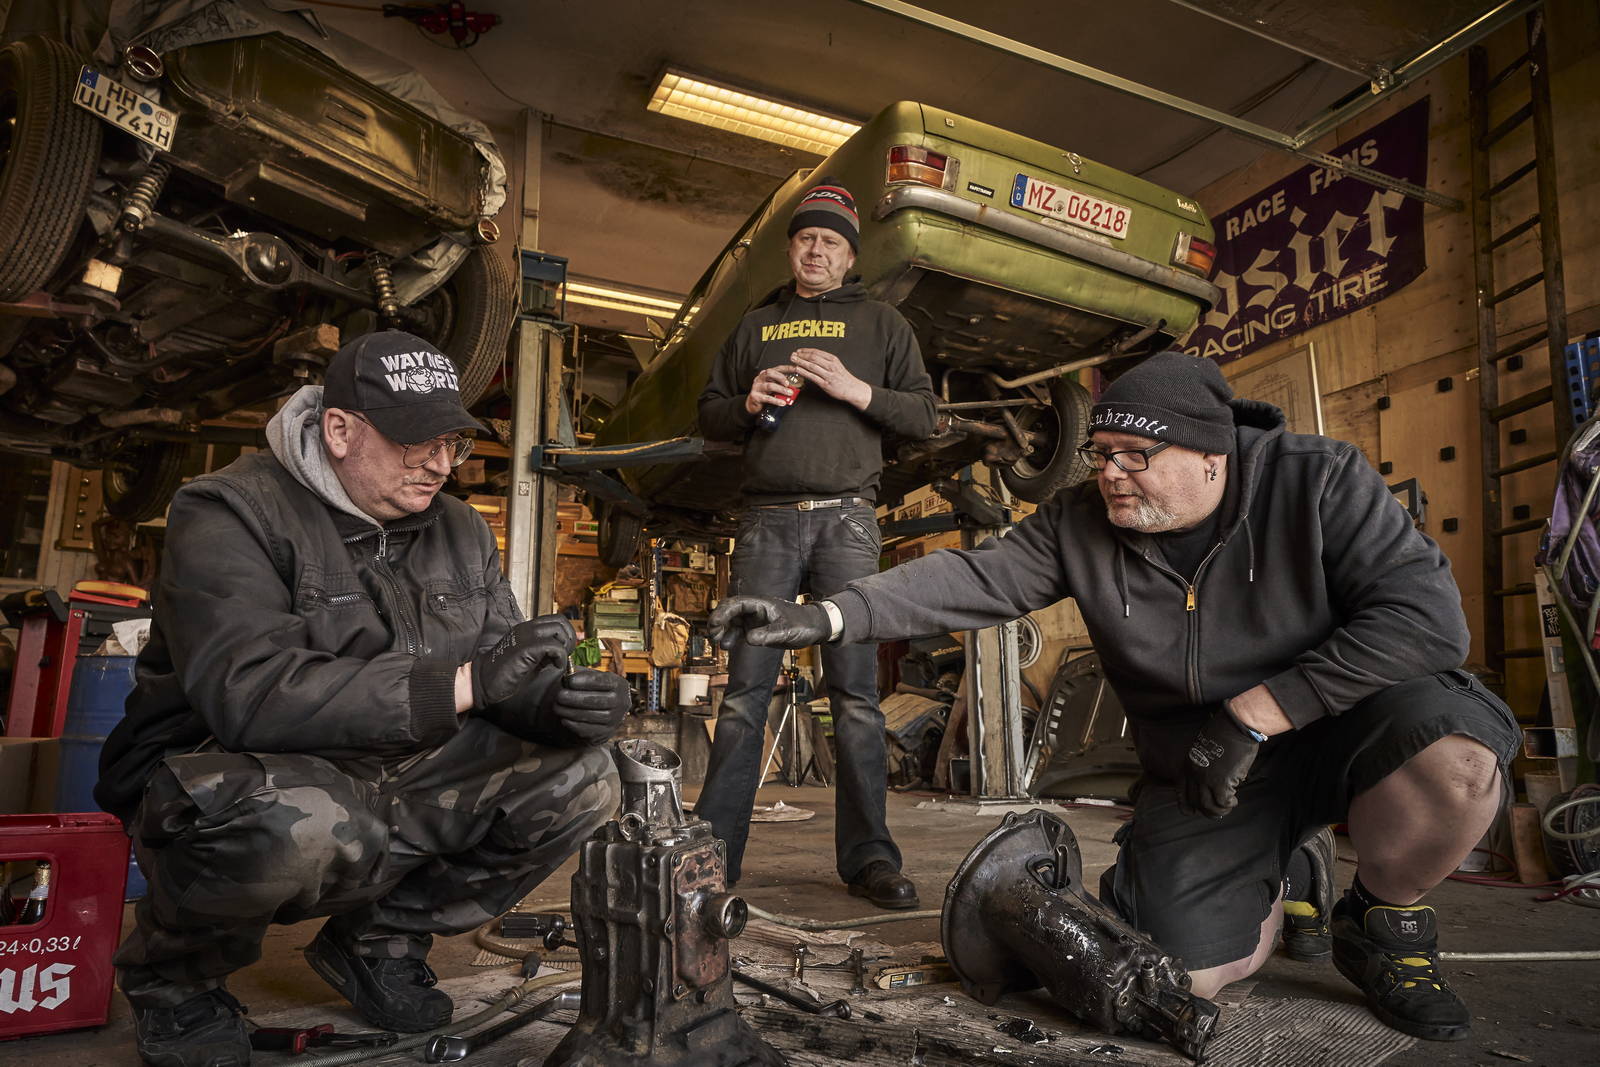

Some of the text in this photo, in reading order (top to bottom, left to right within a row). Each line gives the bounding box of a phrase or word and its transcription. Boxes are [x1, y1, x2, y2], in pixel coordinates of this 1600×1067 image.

[107, 82, 138, 111] HH
[116, 105, 170, 147] 741H
[1016, 193, 1022, 201] D
[1028, 182, 1126, 233] MZ 06218
[1225, 190, 1287, 241] RACE
[1310, 262, 1389, 314] TIRE
[761, 319, 846, 342] WRECKER
